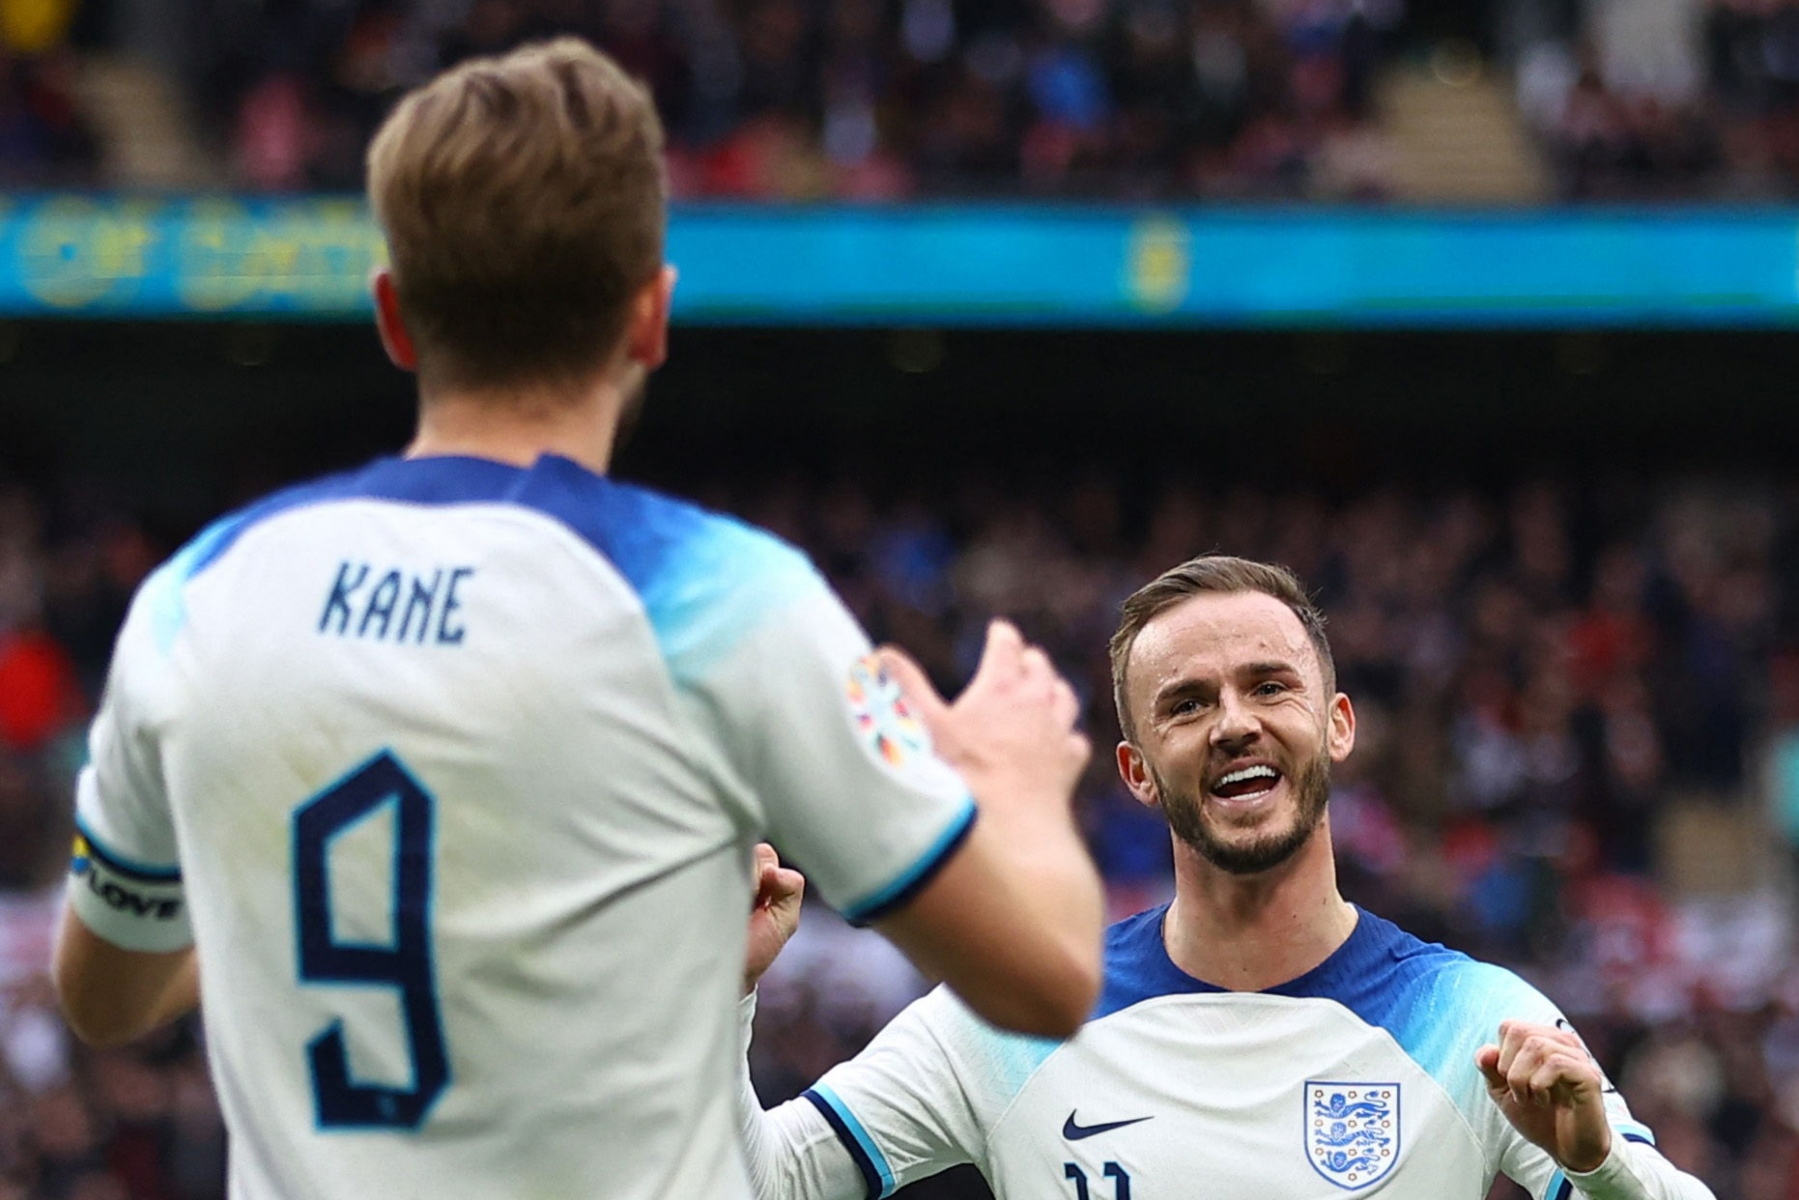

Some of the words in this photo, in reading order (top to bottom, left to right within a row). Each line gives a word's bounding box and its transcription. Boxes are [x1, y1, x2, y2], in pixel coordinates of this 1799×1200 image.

[316, 561, 476, 645] KANE
[89, 865, 184, 921] LOVE
[290, 746, 452, 1133] 9
